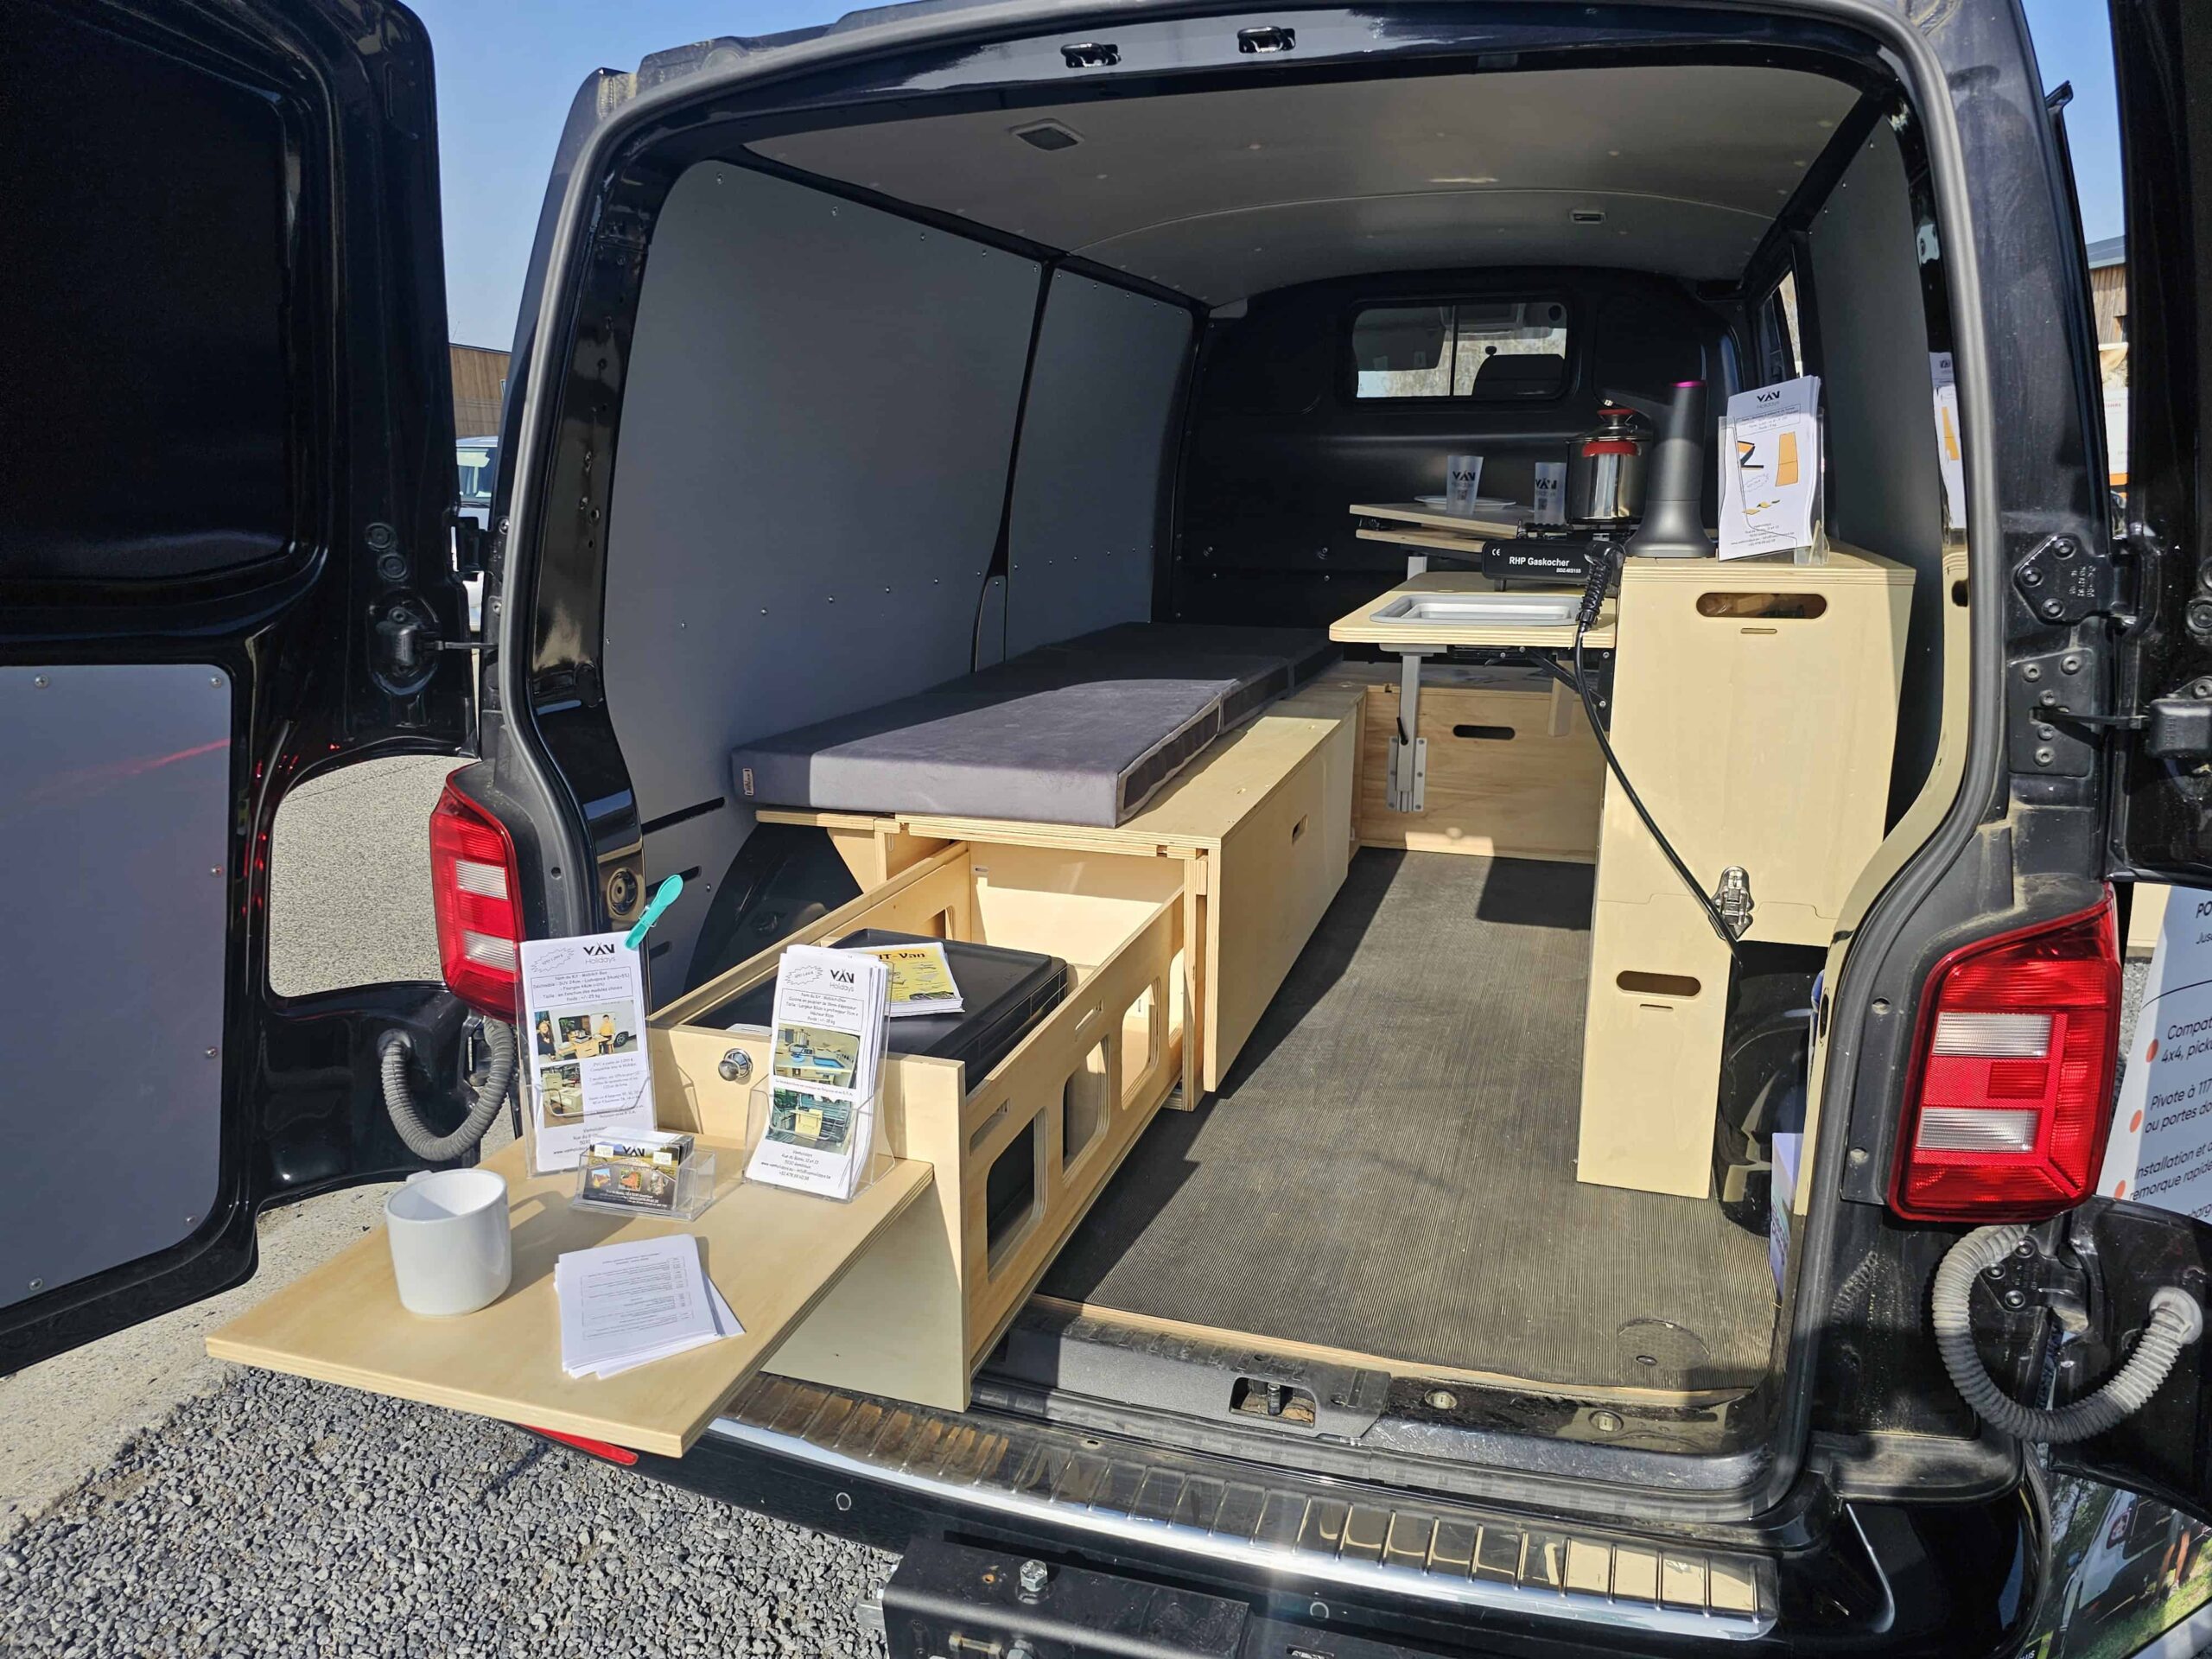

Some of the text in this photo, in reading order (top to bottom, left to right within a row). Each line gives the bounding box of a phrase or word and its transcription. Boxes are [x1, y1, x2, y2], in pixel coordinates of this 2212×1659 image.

[1509, 556, 1570, 567] RHP Gaskocher
[583, 943, 615, 956] VAN
[830, 969, 855, 983] VAN
[830, 982, 855, 993] Holidays
[2161, 1045, 2183, 1064] 4x4,
[2150, 1090, 2185, 1111] Pivote
[2187, 1084, 2196, 1099] à
[2145, 1120, 2159, 1134] ou
[2160, 1107, 2197, 1132] portes
[2134, 1150, 2195, 1180] Installation
[2196, 1143, 2207, 1158] et
[2129, 1175, 2182, 1201] remorque
